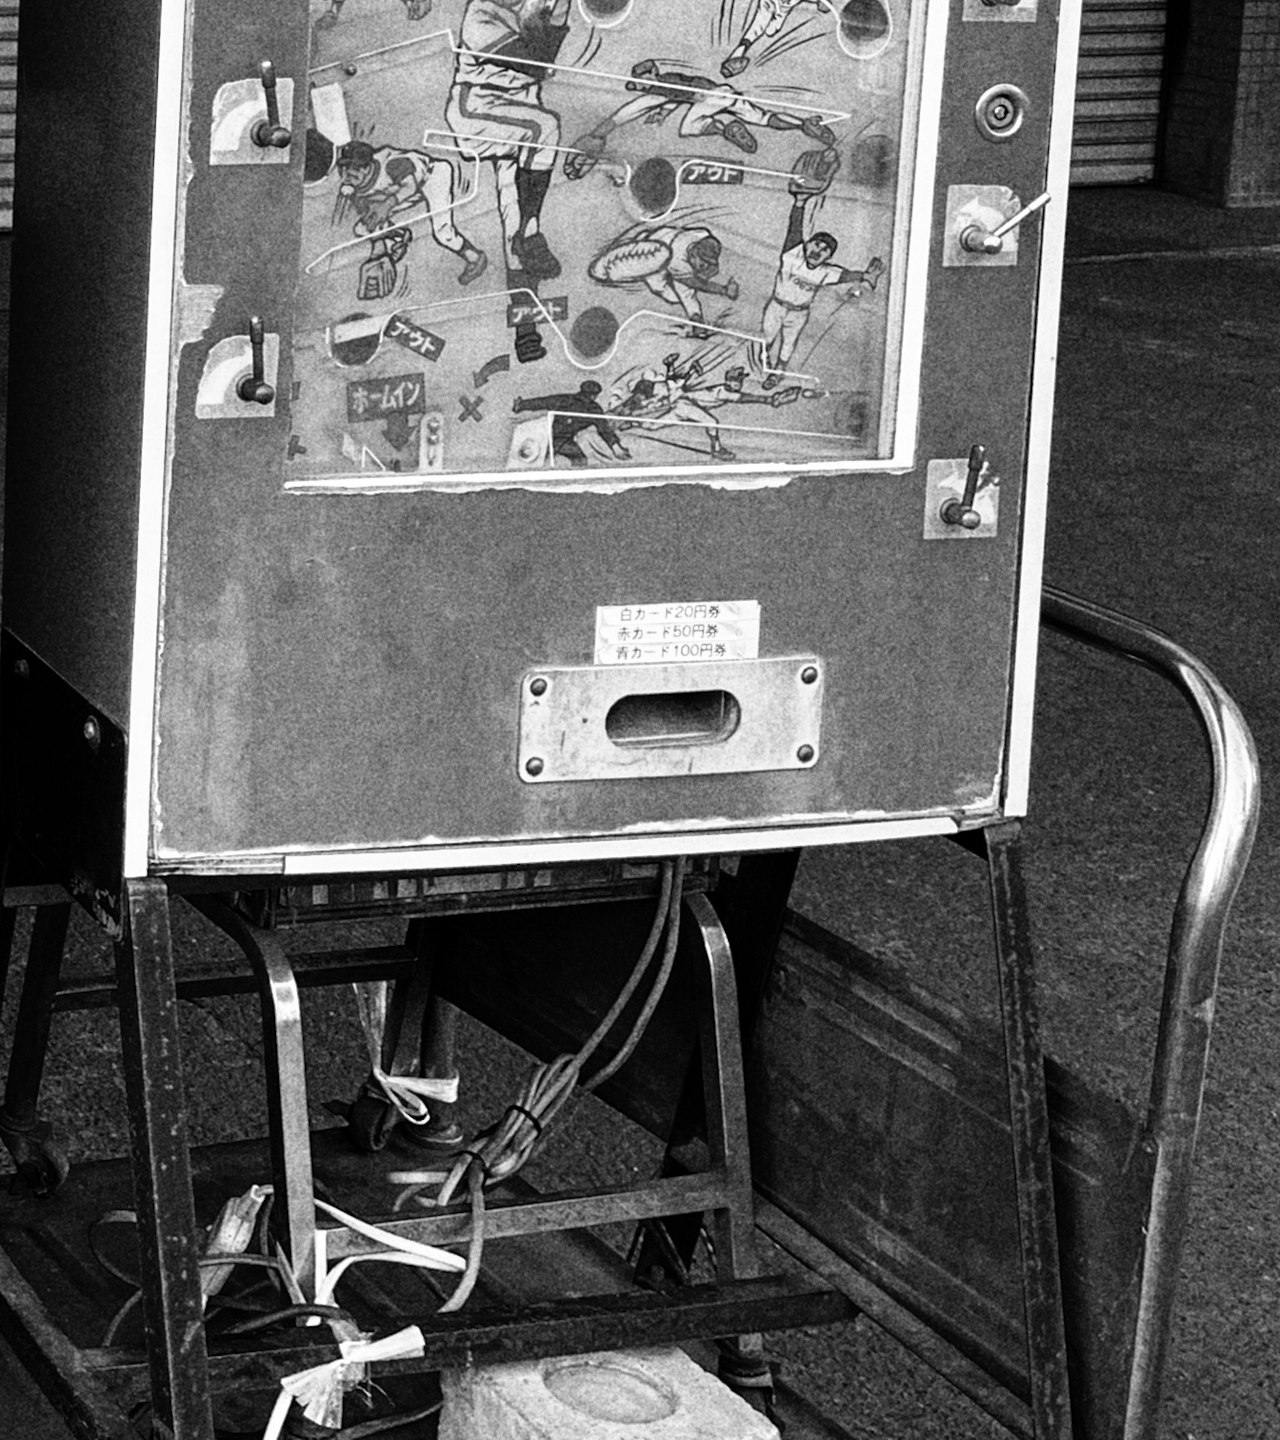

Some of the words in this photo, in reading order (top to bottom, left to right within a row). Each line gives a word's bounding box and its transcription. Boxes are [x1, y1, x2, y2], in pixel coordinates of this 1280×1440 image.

[687, 164, 742, 183] アウト
[512, 303, 562, 324] アウト
[389, 320, 438, 354] アウト
[352, 380, 420, 415] ホームイン
[620, 604, 721, 622] 白カード20円券
[617, 623, 719, 642] 赤カード50円券
[615, 642, 727, 661] 青カード100円券
